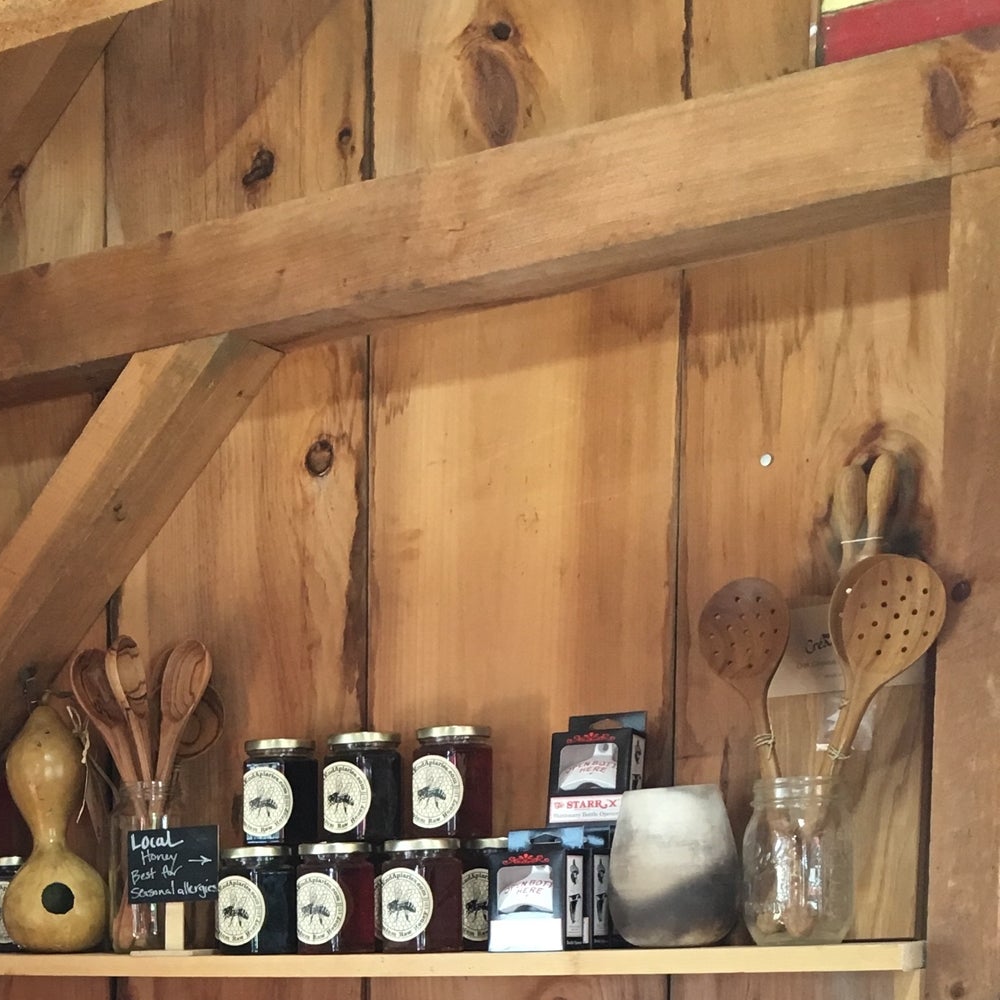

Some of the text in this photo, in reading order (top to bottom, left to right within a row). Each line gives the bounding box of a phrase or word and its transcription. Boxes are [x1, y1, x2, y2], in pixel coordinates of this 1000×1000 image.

[579, 766, 608, 775] HERE
[130, 829, 185, 851] Local
[140, 848, 178, 873] Honey
[131, 864, 183, 886] Best for
[516, 886, 544, 895] HERE
